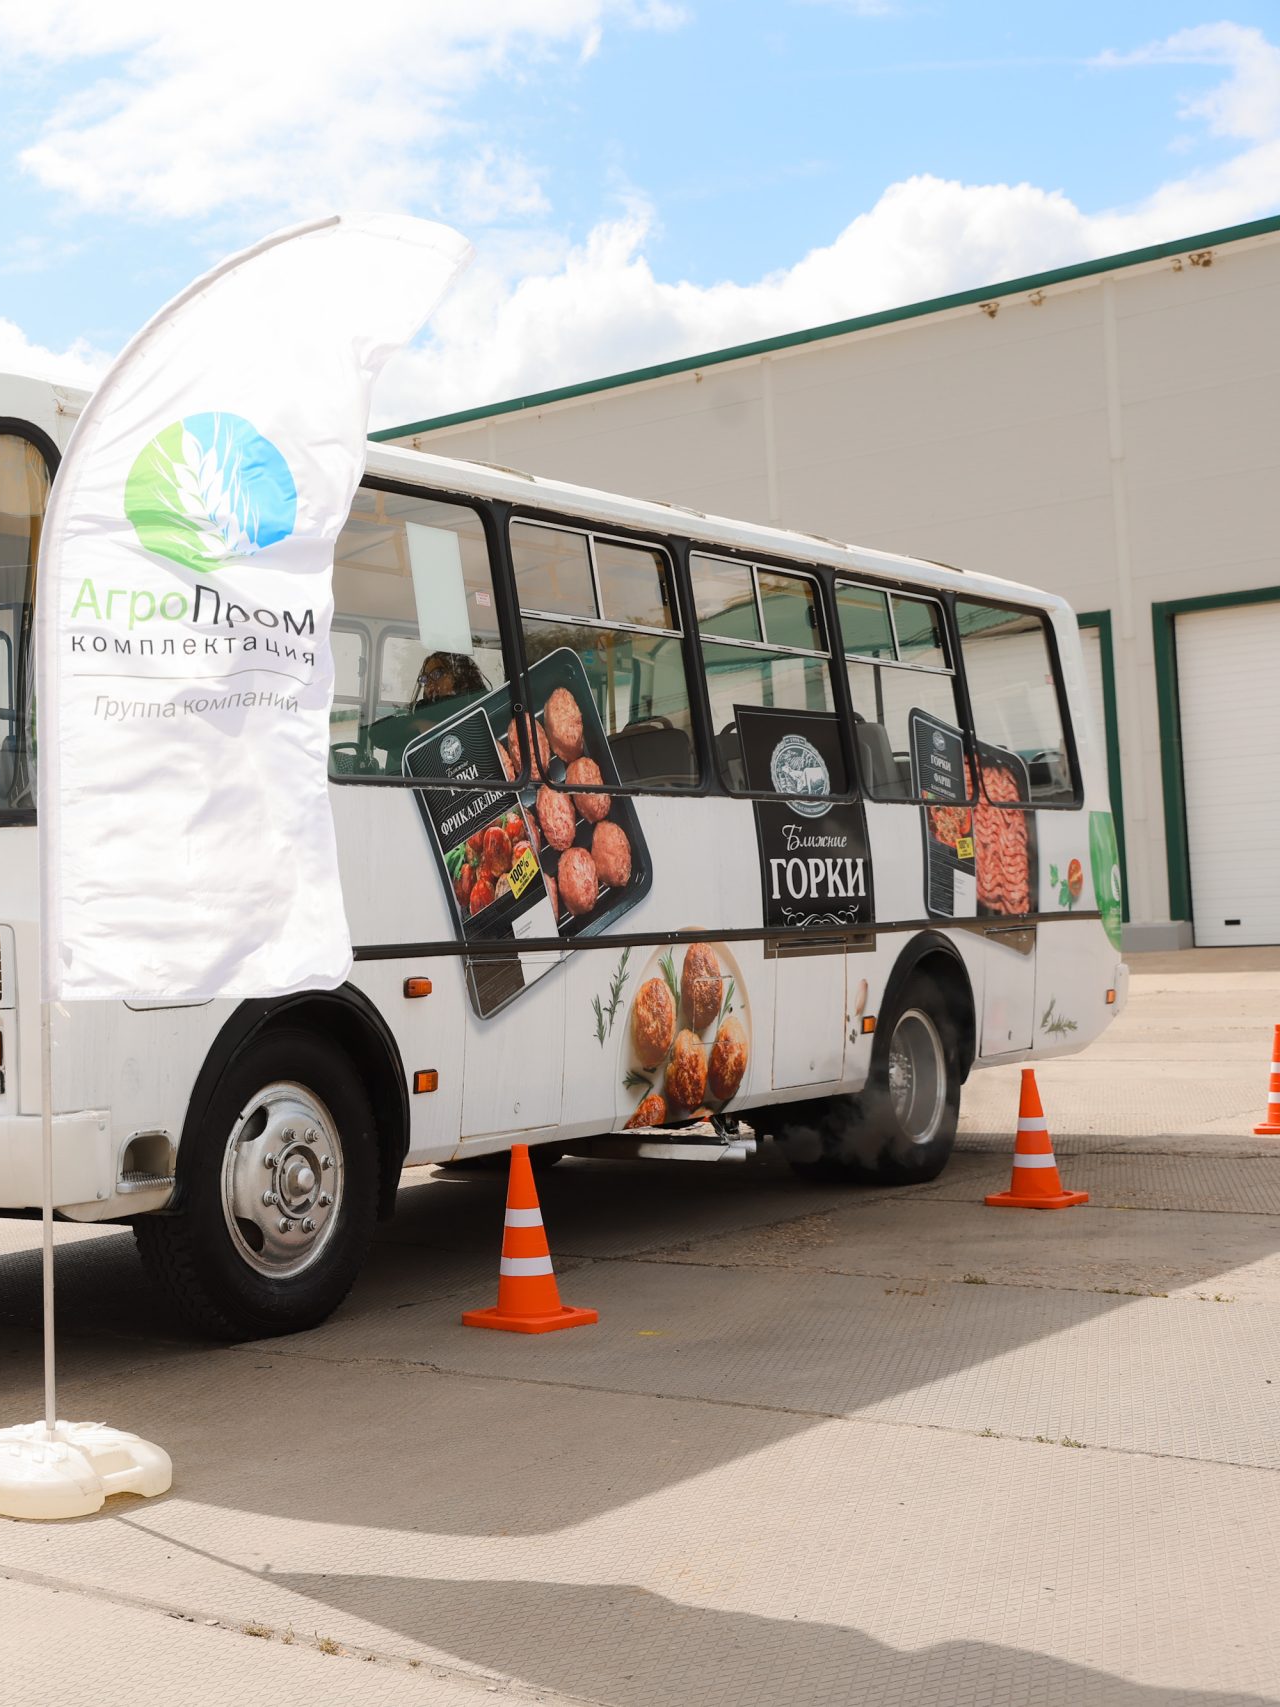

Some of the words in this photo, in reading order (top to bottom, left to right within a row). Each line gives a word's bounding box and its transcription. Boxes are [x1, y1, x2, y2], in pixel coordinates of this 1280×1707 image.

[71, 578, 315, 636] АгроПром
[72, 635, 315, 667] комплектация
[93, 695, 176, 722] Группа
[184, 689, 299, 714] компаний
[441, 791, 506, 836] ФРИКАДЕЛЬК
[782, 824, 847, 851] Ближние
[770, 857, 866, 899] ГОРКИ
